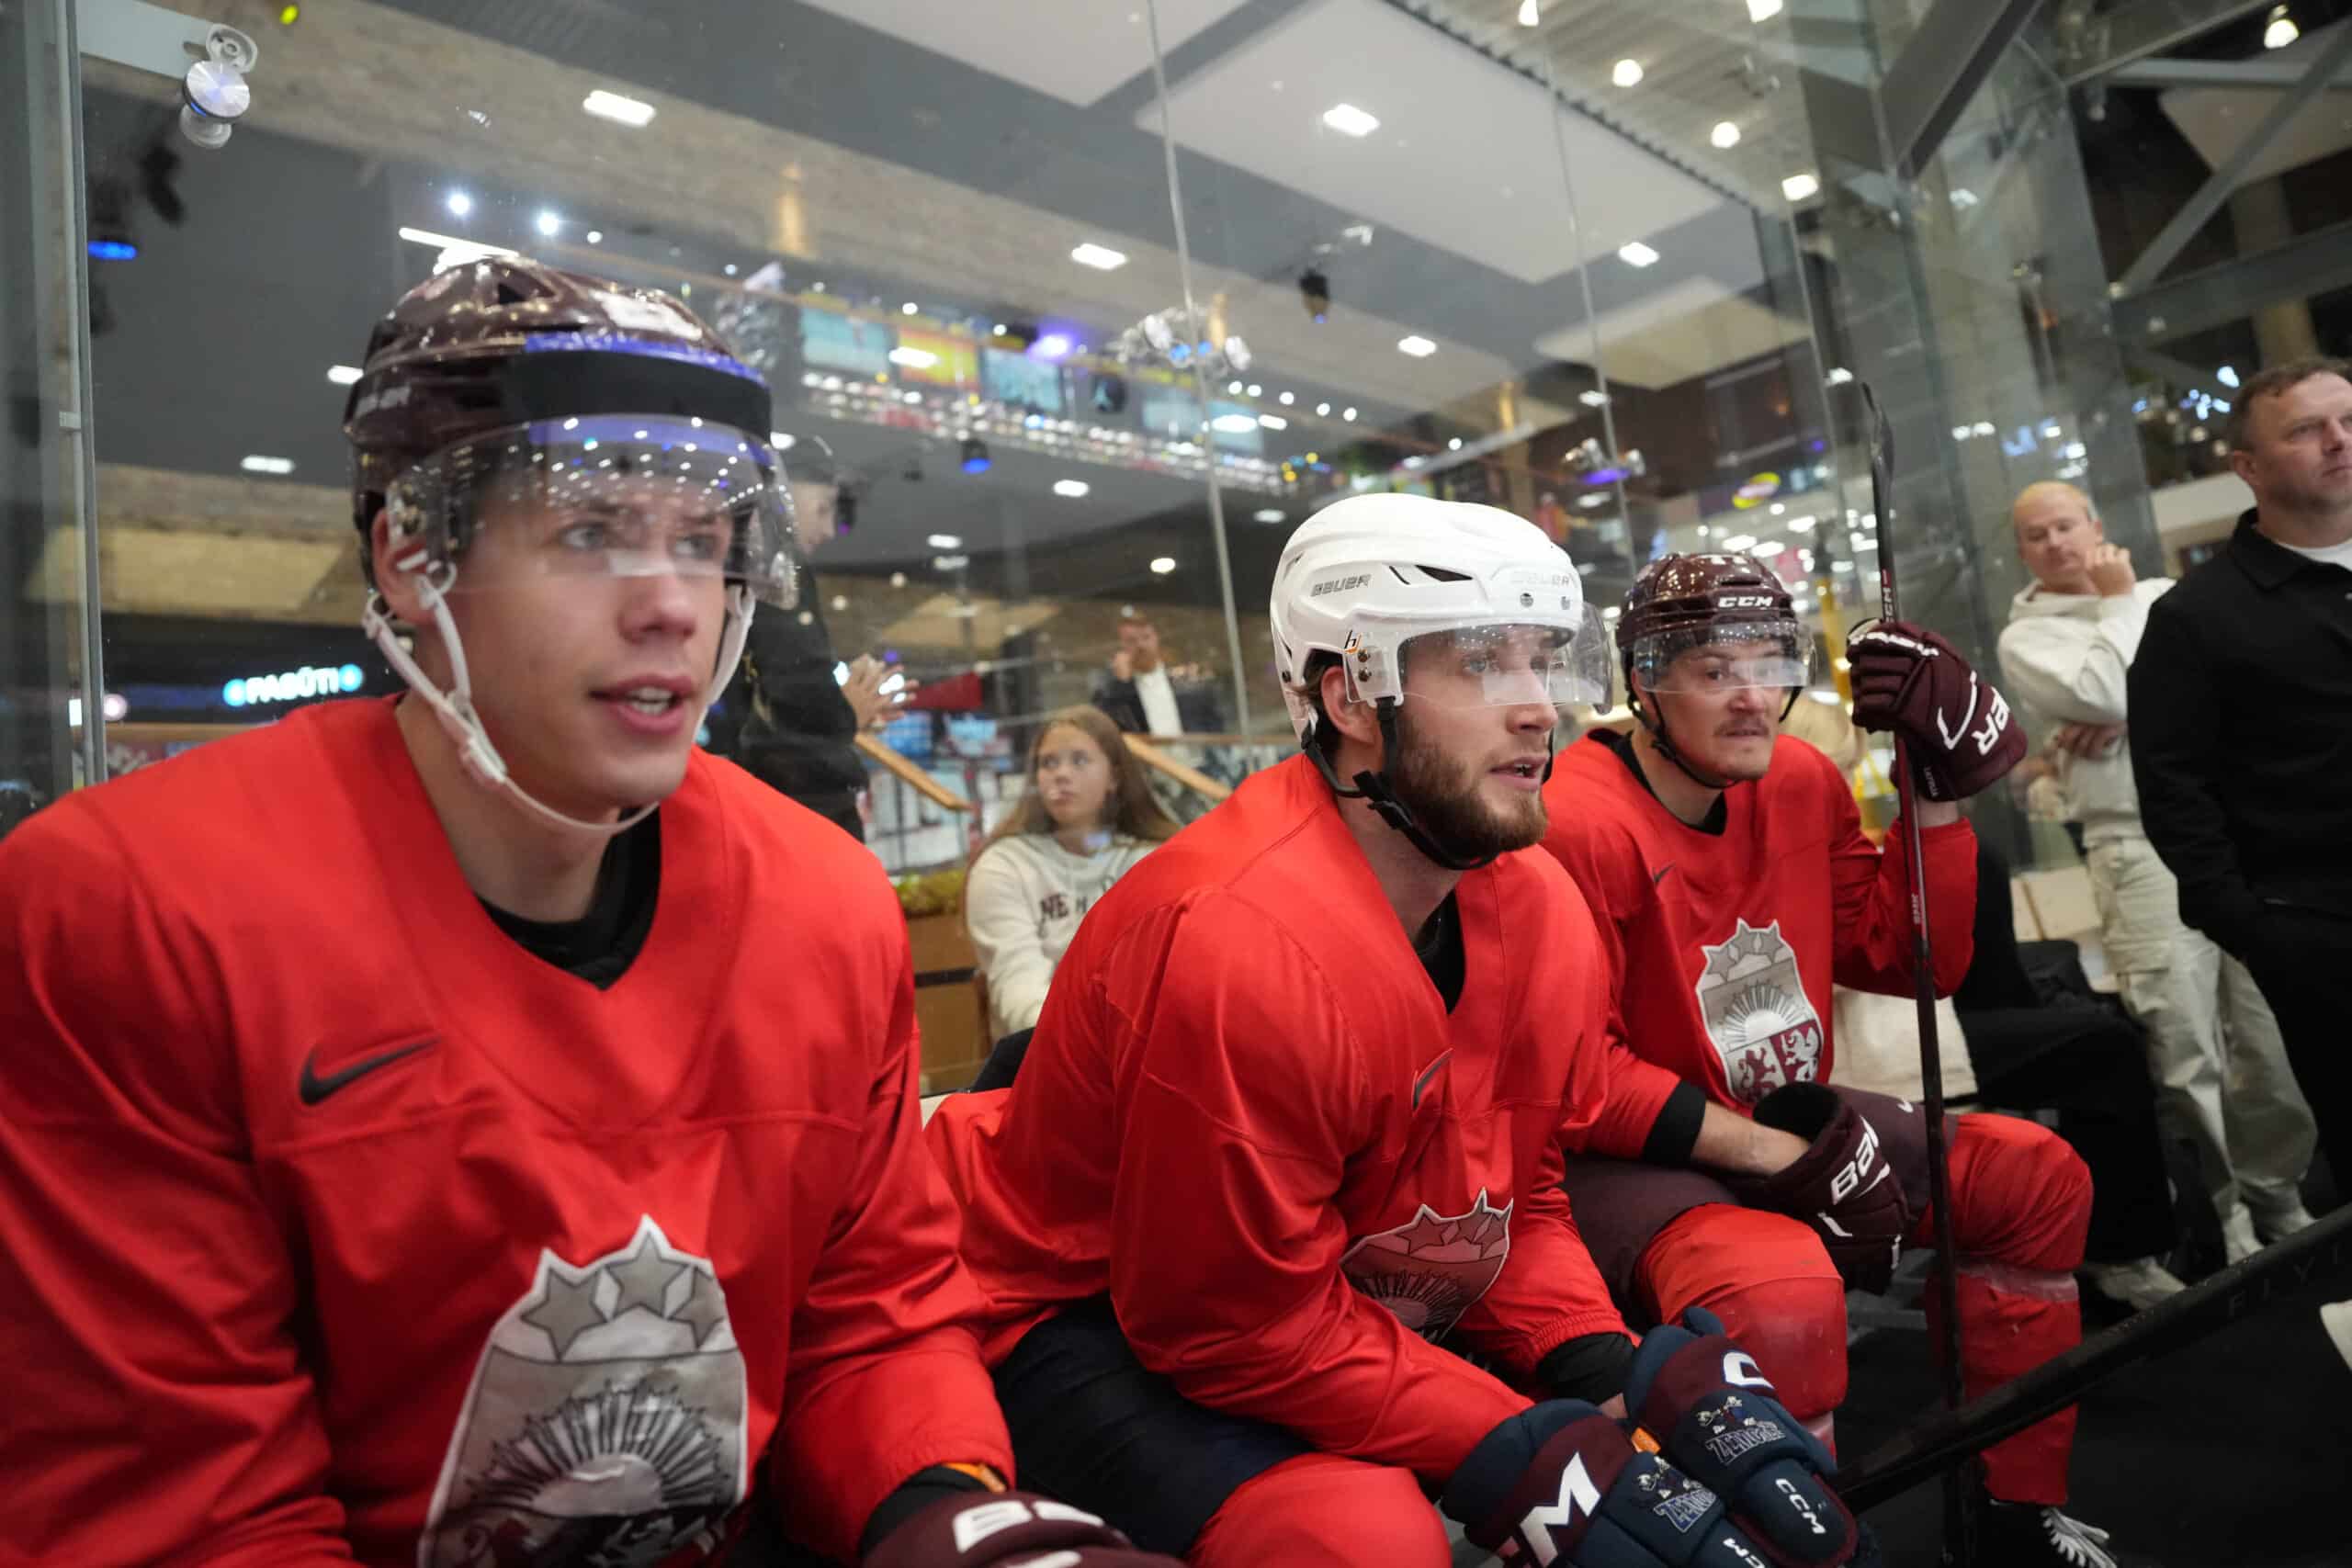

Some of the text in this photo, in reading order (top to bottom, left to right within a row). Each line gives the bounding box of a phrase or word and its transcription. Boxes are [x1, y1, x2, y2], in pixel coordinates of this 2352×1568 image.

[1310, 574, 1372, 597] BAUER
[1717, 595, 1774, 608] CCM
[1775, 1477, 1827, 1535] CCM
